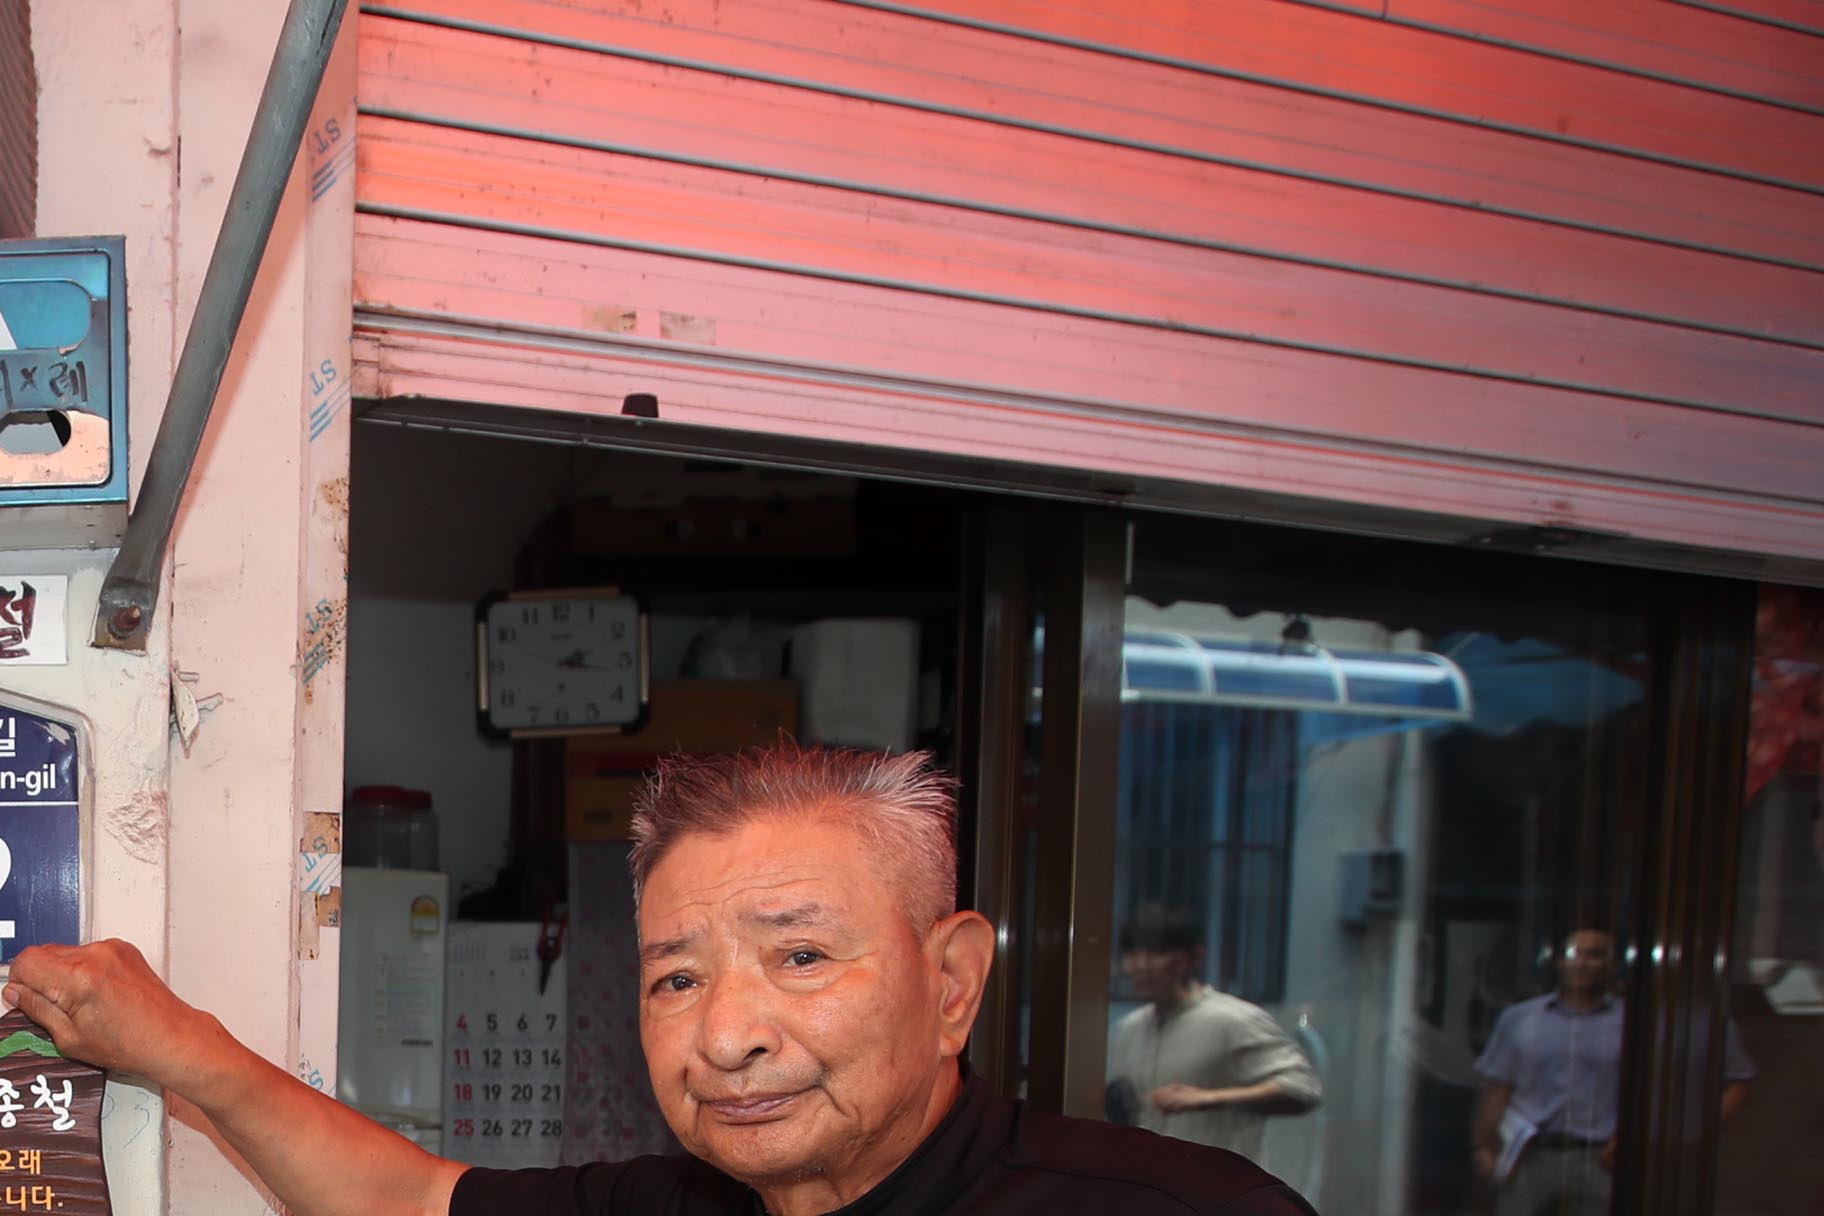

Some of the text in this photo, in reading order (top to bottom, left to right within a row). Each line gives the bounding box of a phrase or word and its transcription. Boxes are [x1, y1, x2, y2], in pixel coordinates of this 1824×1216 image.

[311, 117, 343, 159] ST
[303, 835, 329, 874] ST
[457, 1013, 557, 1031] 4 5 6 7
[453, 1048, 561, 1067] 11 12 13 14
[453, 1083, 561, 1102] 18 19 20 21
[453, 1119, 563, 1137] 25 26 27 28
